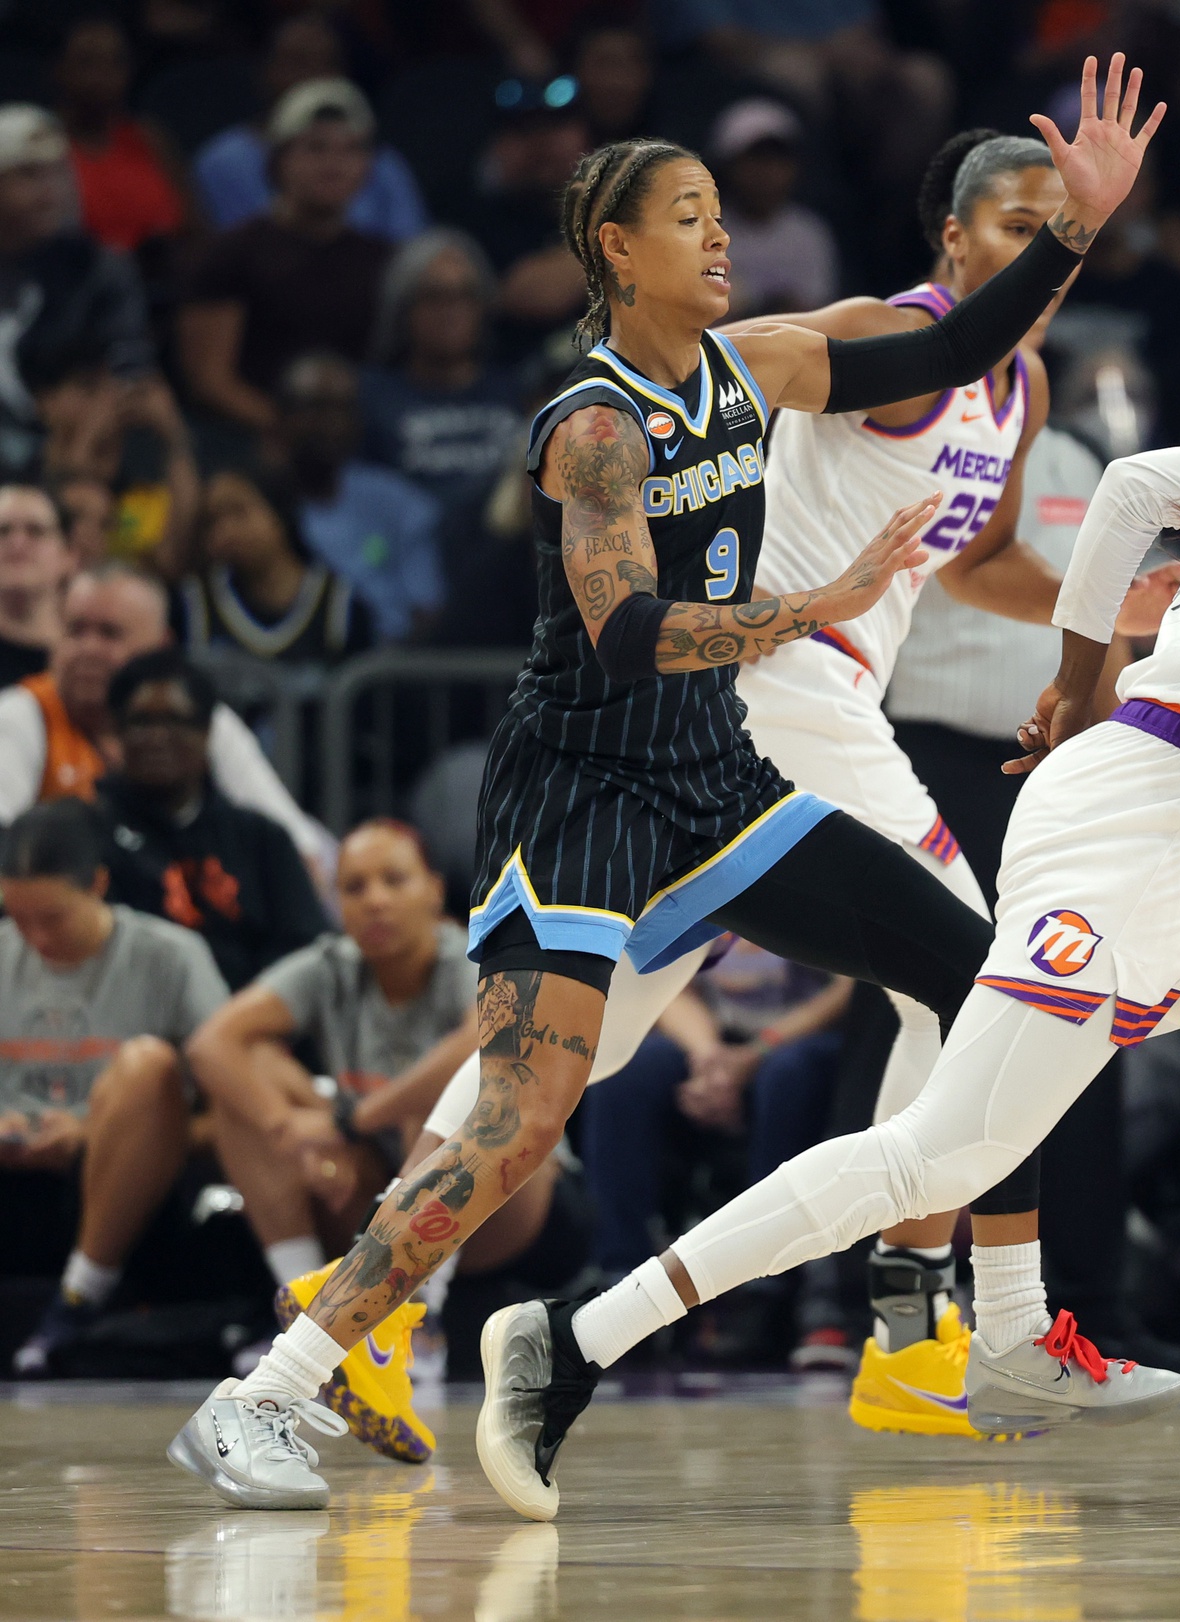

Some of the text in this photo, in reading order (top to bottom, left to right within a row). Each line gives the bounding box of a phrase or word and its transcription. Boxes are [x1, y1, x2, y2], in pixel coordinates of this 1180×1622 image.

[705, 527, 740, 601] 9
[520, 1020, 550, 1044] God
[549, 1030, 559, 1045] is
